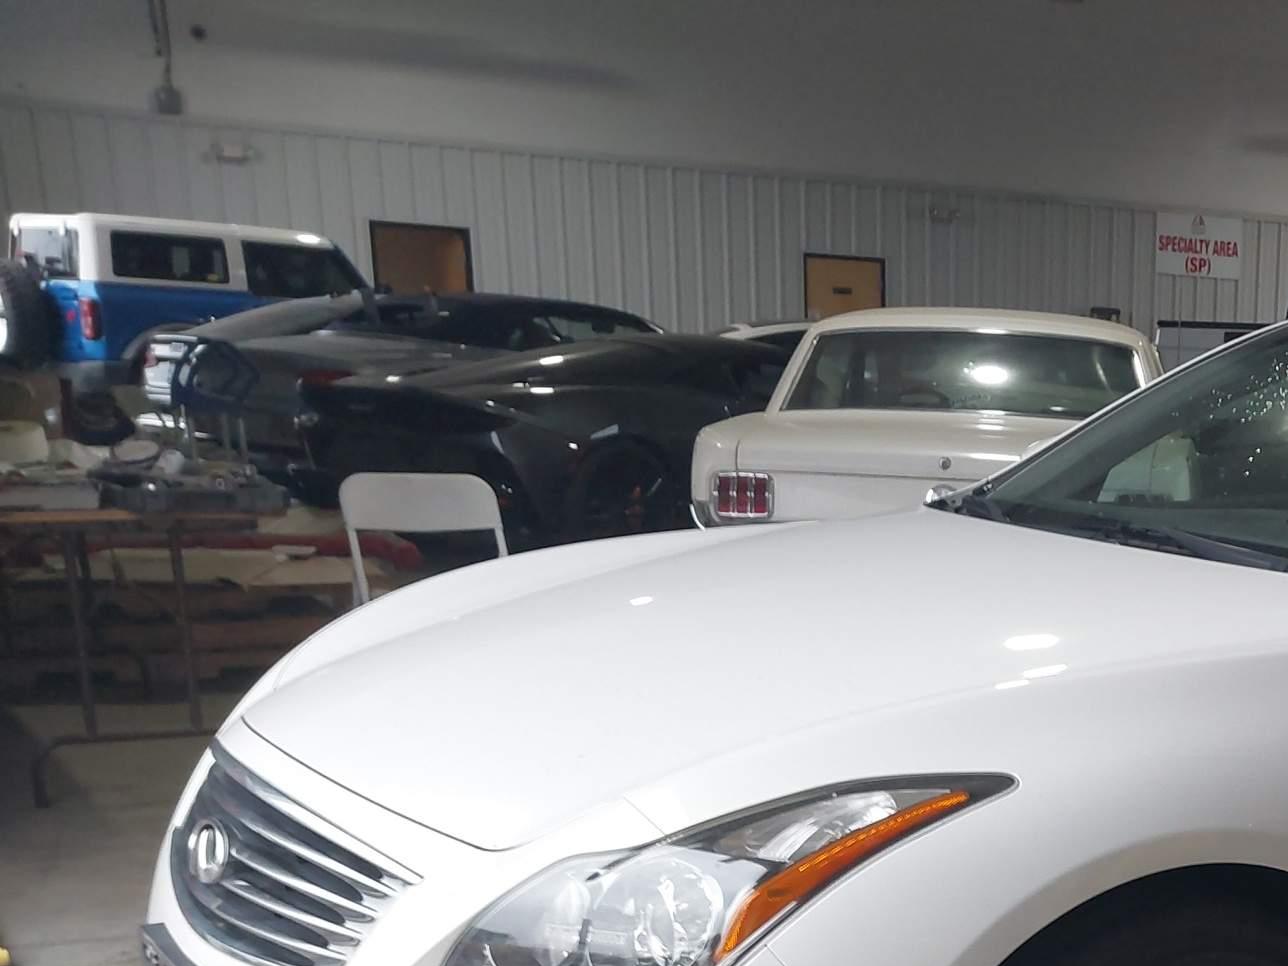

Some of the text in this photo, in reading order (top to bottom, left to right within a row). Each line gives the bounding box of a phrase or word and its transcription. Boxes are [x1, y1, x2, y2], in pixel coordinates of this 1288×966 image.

[1158, 234, 1239, 257] SPECIALTY AREA
[1185, 256, 1212, 275] (SP)
